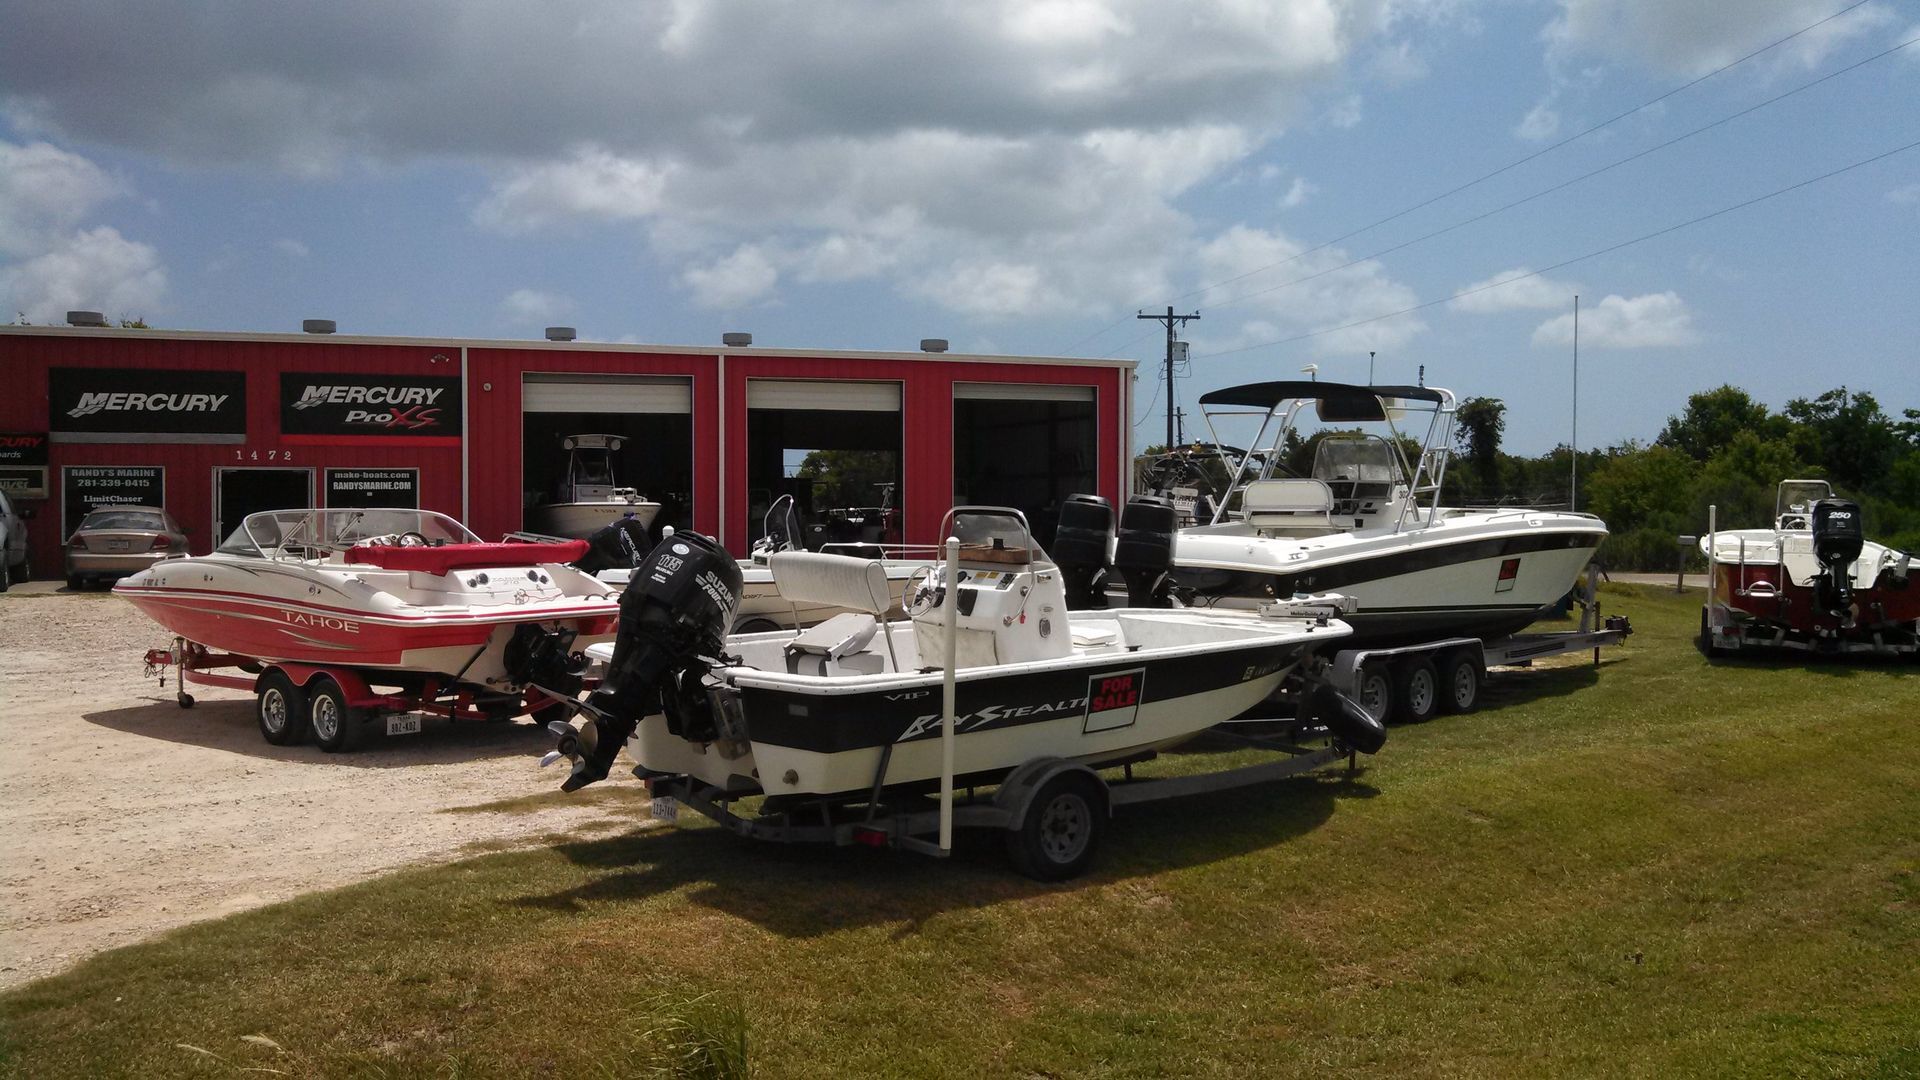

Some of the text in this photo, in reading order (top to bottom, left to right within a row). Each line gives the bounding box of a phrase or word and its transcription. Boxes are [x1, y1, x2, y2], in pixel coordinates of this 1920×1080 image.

[69, 392, 229, 415] MERCURY
[296, 385, 444, 407] MERCURY
[71, 469, 156, 477] RANDY'S MARINE
[77, 479, 150, 487] 281-339-0415
[333, 481, 412, 490] RANDYSMARINE.COM
[83, 495, 143, 503] LimitChaser
[1828, 511, 1852, 519] 250
[620, 527, 642, 561] MERCURY
[658, 554, 684, 572] 115
[702, 583, 722, 603] FOUR
[705, 570, 736, 609] SUZUKI
[280, 609, 360, 634] TAHOE
[1101, 675, 1133, 694] FOR
[884, 691, 930, 702] VIP
[1092, 689, 1137, 711] SALE
